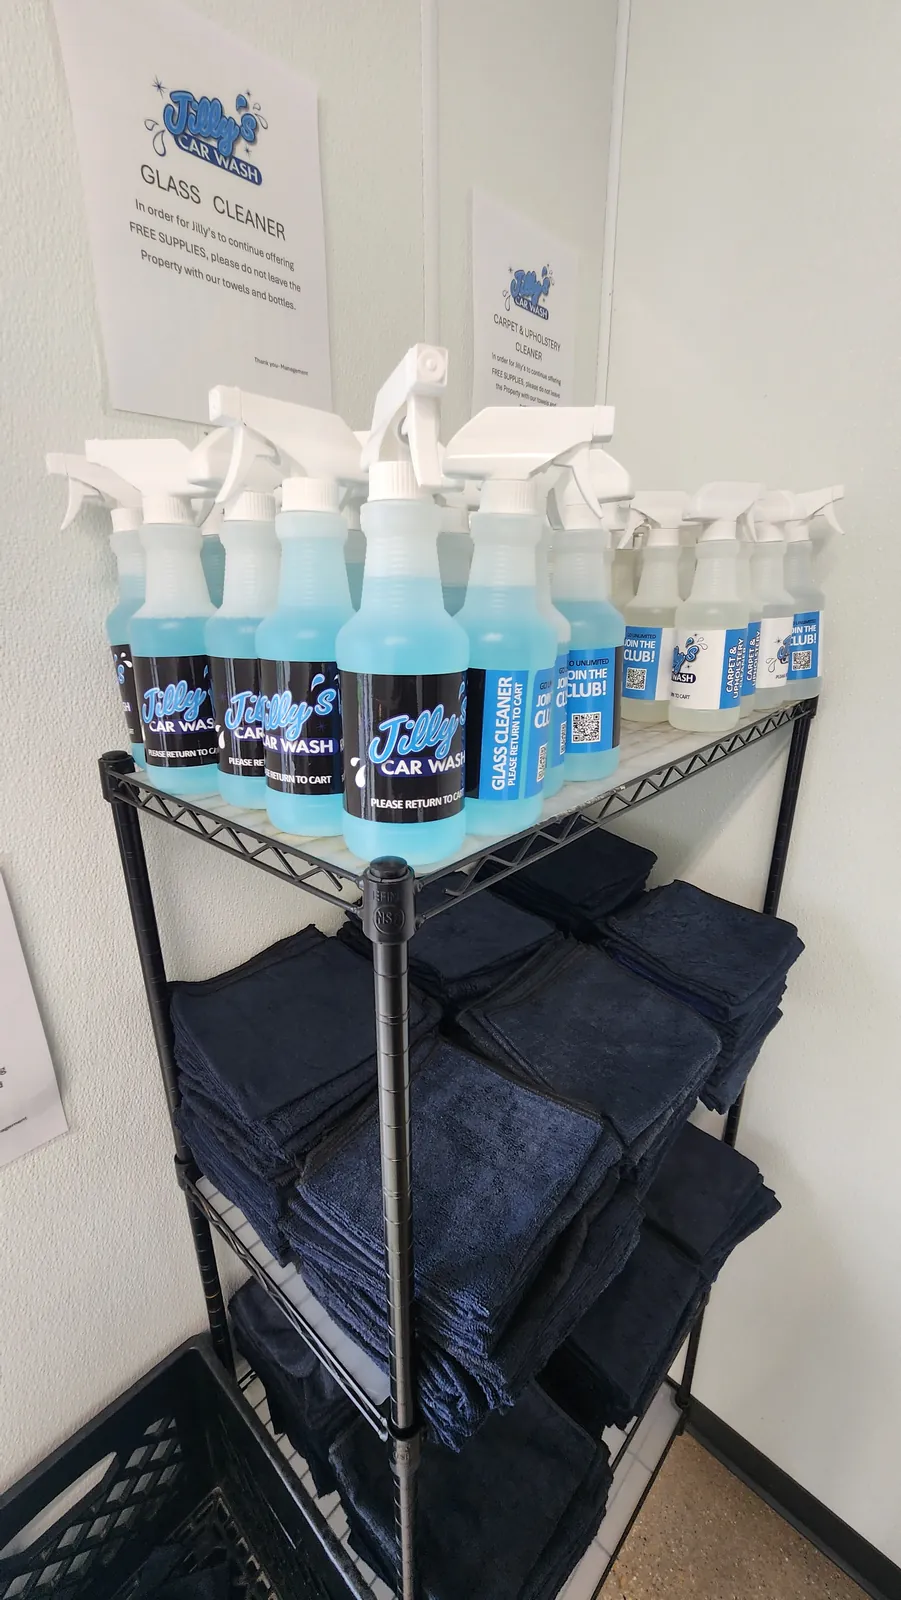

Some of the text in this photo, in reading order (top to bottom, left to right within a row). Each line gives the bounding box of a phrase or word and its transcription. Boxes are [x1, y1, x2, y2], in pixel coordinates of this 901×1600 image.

[163, 90, 258, 157] Jilly's
[177, 135, 259, 183] CAR WASH
[140, 165, 286, 241] GLASS CLEANER
[135, 199, 295, 271] In order for Jilly's to continue offering
[129, 221, 301, 293] FREE SUPPLIES, please do not leave the
[140, 249, 296, 311] Property with our towels and bottles.
[515, 296, 548, 319] CAR WASH
[493, 313, 561, 353] CARPET & UPHOLSTERY
[515, 341, 543, 361] CLEANER
[491, 352, 497, 360] In
[497, 355, 509, 365] order
[526, 366, 531, 374] to
[531, 369, 548, 380] continue
[548, 375, 561, 387] offering
[492, 367, 503, 379] FREE
[504, 371, 525, 387] SUPPLIES,
[525, 381, 539, 391] please
[551, 390, 561, 399] leave
[503, 385, 521, 399] Property
[537, 397, 550, 407] towels
[804, 624, 817, 632] THE
[624, 649, 656, 663] CLUB!
[640, 640, 656, 649] THE
[567, 669, 587, 680] OIN
[589, 668, 608, 680] THE
[576, 658, 609, 667] UNLIMITED
[726, 646, 737, 693] CARPET &
[733, 638, 744, 699] UPHOLSTERY
[747, 648, 755, 681] CARPET
[672, 673, 694, 683] WASH
[149, 720, 176, 733] CAR
[178, 717, 215, 732] WAS
[234, 726, 265, 740] CAR
[492, 676, 513, 791] GLASS CLEANER
[508, 682, 524, 786] PLEASE RETURN TO CART
[148, 749, 167, 758] PLEASE
[167, 750, 196, 758] RETURN
[197, 748, 208, 756] TO
[280, 738, 333, 754] WASH
[228, 756, 253, 767] PLEASE
[381, 749, 466, 775] CAR WASH
[270, 769, 295, 784] RETURN
[295, 775, 308, 784] TO
[309, 775, 332, 785] CART
[371, 797, 404, 810] PLEASE
[405, 796, 442, 810] RETURN
[443, 793, 453, 805] TO
